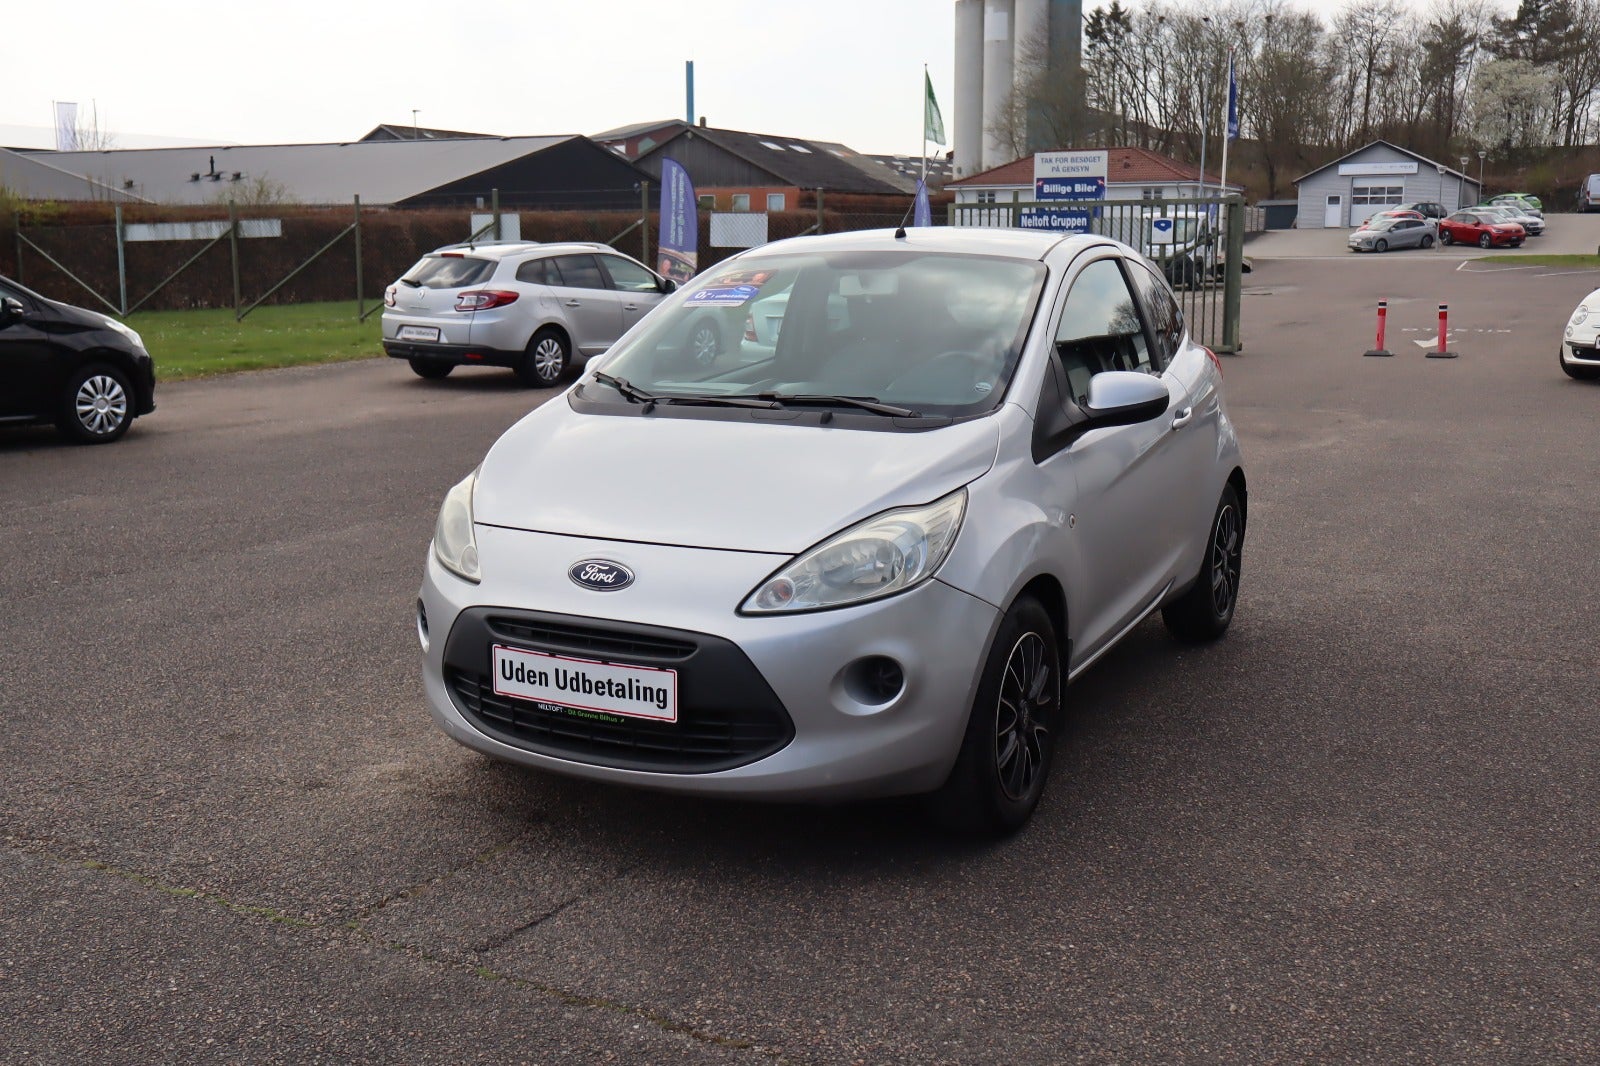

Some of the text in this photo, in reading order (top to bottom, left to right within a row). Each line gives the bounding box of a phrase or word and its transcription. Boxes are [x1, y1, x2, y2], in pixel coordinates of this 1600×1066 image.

[1062, 165, 1090, 173] GENSYN
[1043, 183, 1097, 194] Billige Biler
[1021, 214, 1087, 229] Neltoft Gruppen
[580, 563, 617, 583] Ford
[501, 658, 668, 710] Uden Udbetaling
[538, 703, 563, 713] NELTOFT
